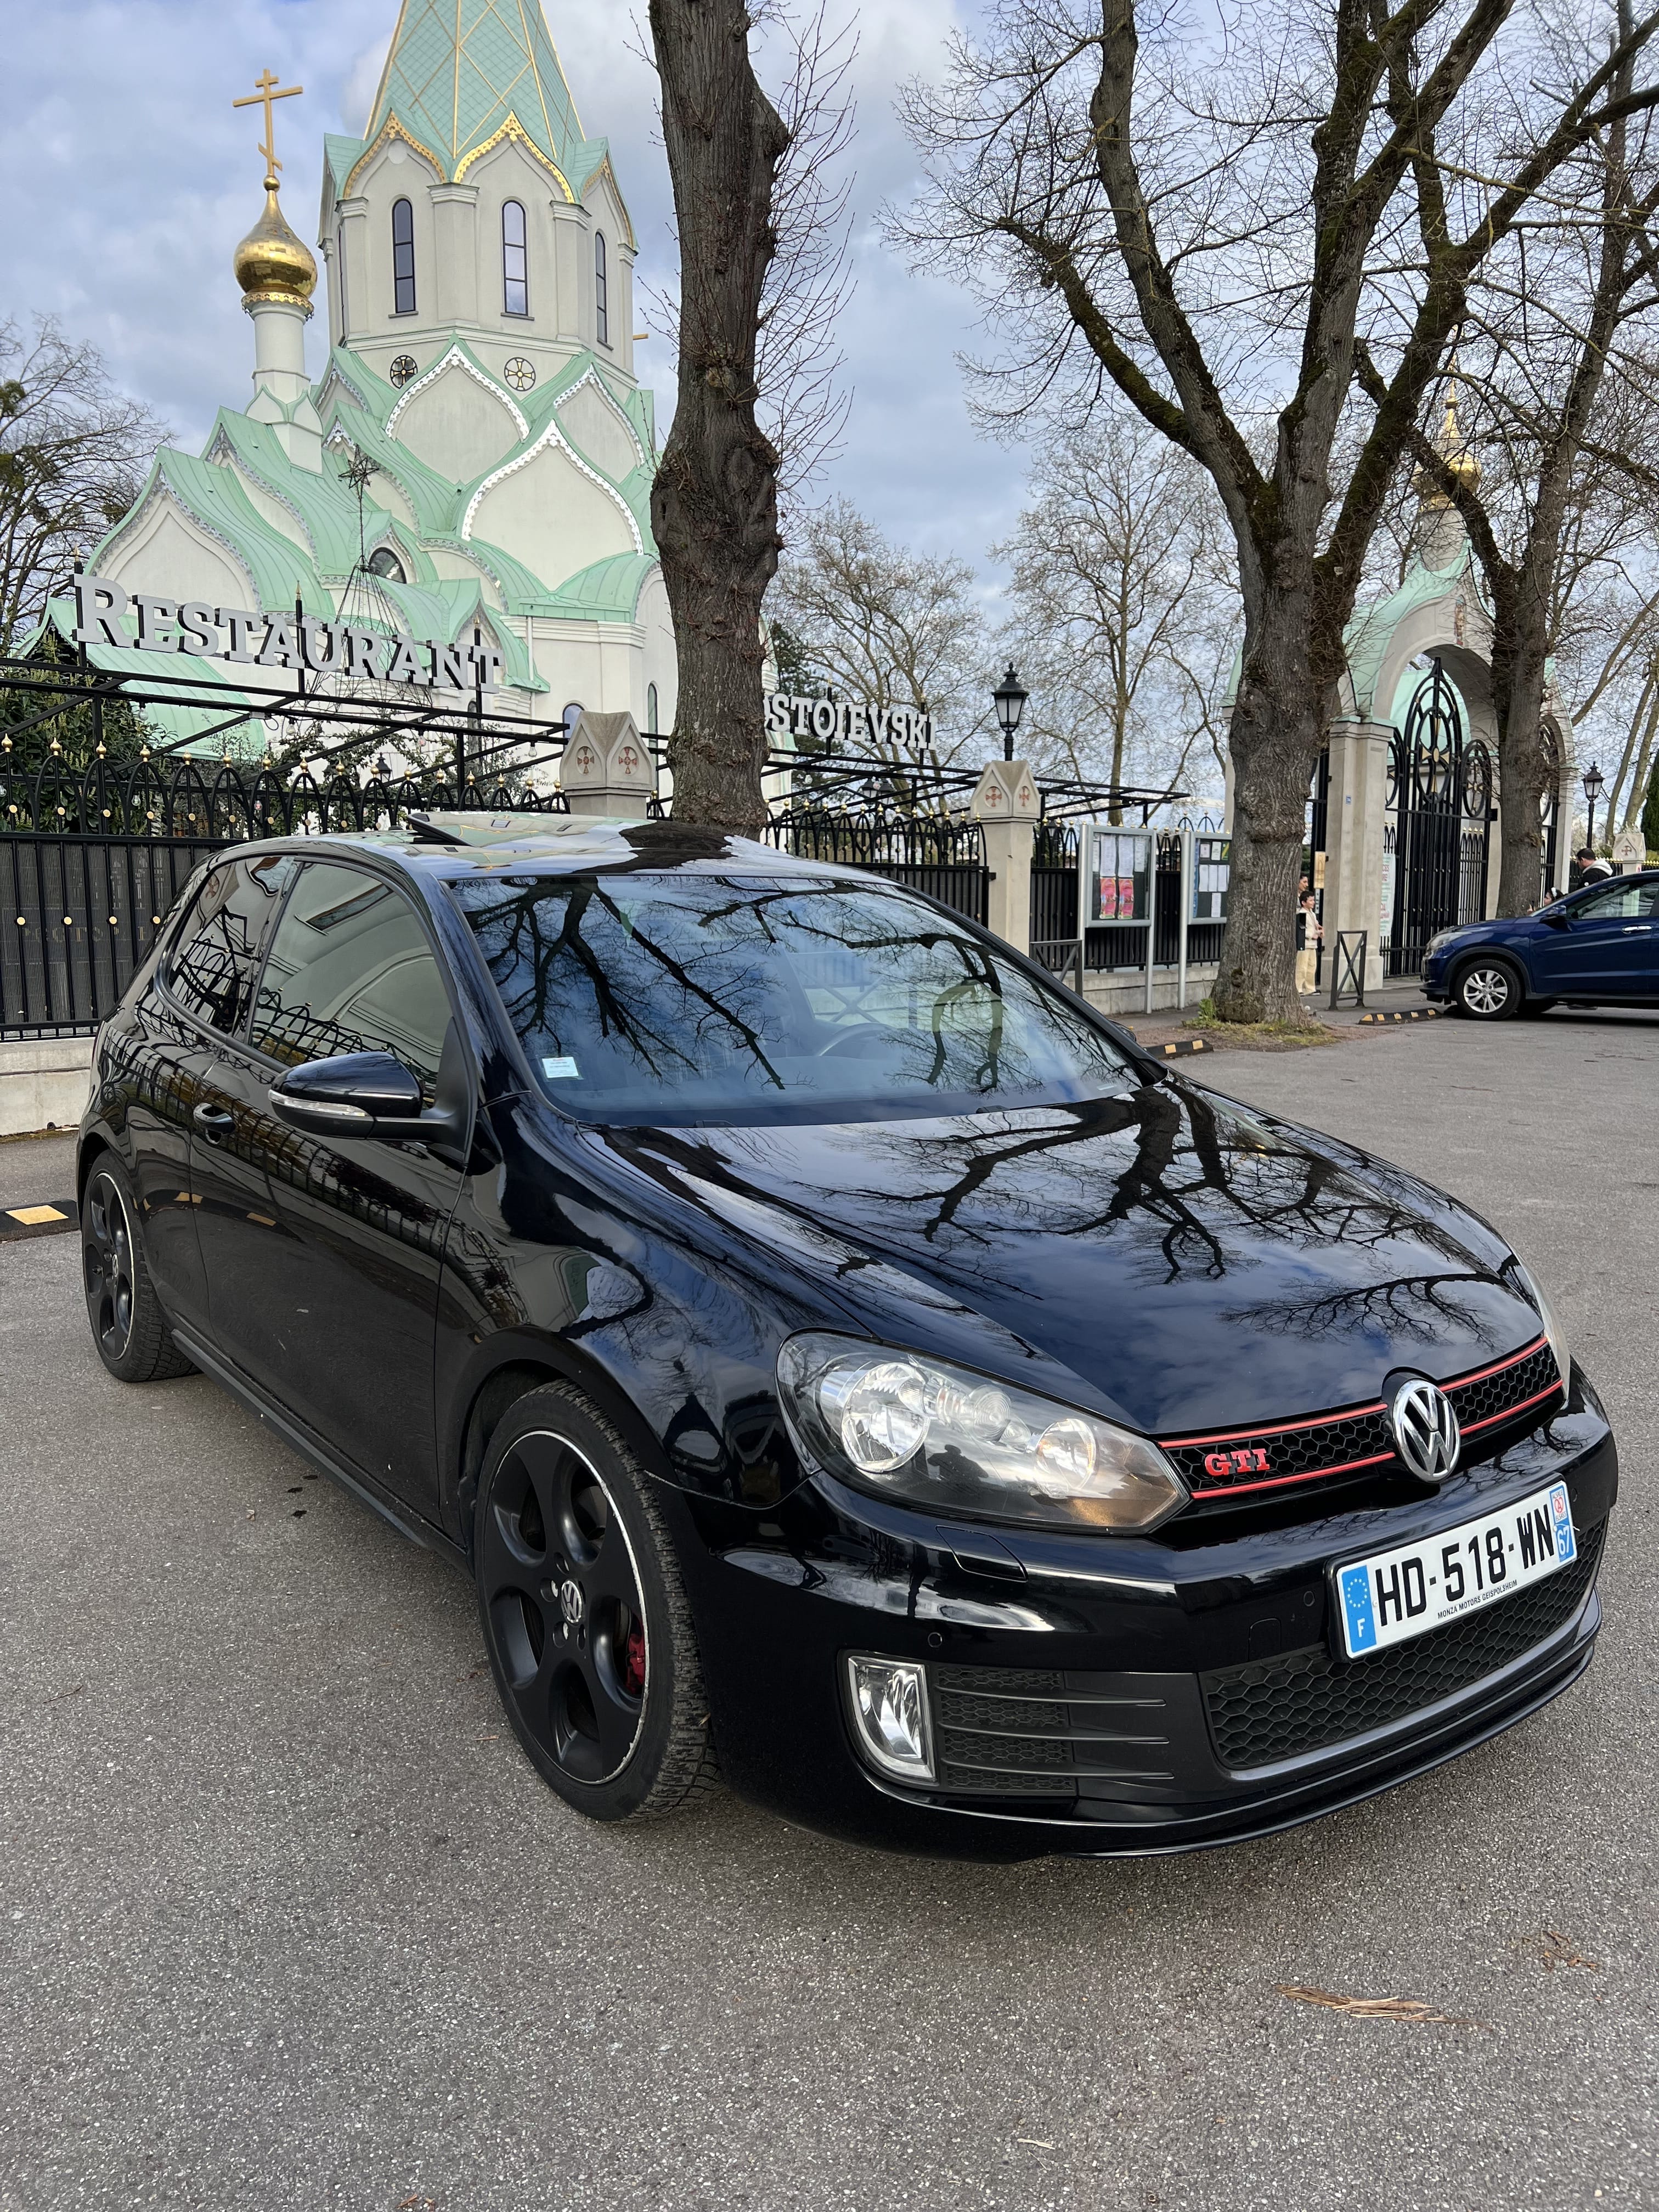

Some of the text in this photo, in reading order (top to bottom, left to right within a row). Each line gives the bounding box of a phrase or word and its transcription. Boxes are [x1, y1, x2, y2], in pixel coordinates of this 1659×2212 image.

[73, 573, 505, 694] RESTAURANT
[1205, 1448, 1270, 1477] GTI
[1557, 1525, 1569, 1556] 67
[1375, 1504, 1555, 1627] HD-518-WN
[1437, 1579, 1517, 1619] MONZA MOTORS GEISPOLSHEIM
[1357, 1618, 1365, 1638] F
